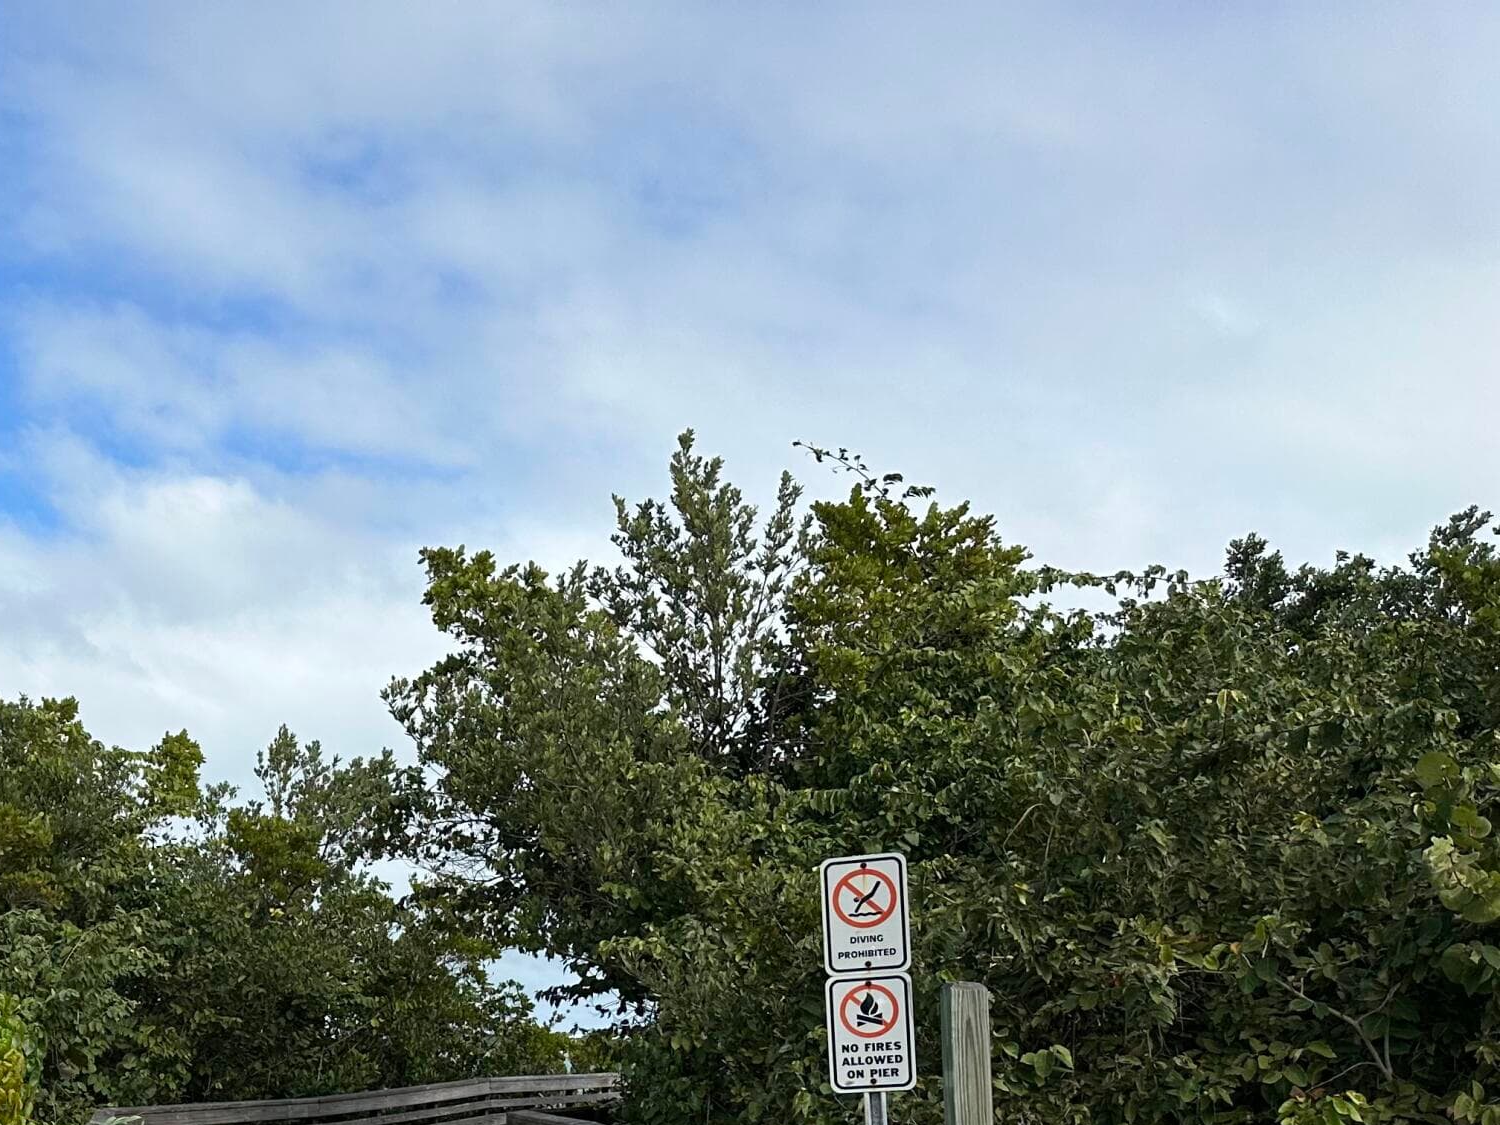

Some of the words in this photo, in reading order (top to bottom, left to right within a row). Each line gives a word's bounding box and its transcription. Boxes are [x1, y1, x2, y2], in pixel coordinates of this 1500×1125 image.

[849, 934, 884, 944] DIVING
[837, 947, 897, 959] PROHIBITED
[841, 1042, 859, 1053] NO
[864, 1041, 902, 1052] FIRES
[841, 1054, 903, 1066] ALLOWED
[847, 1069, 865, 1079] ON
[870, 1067, 899, 1078] PIER
